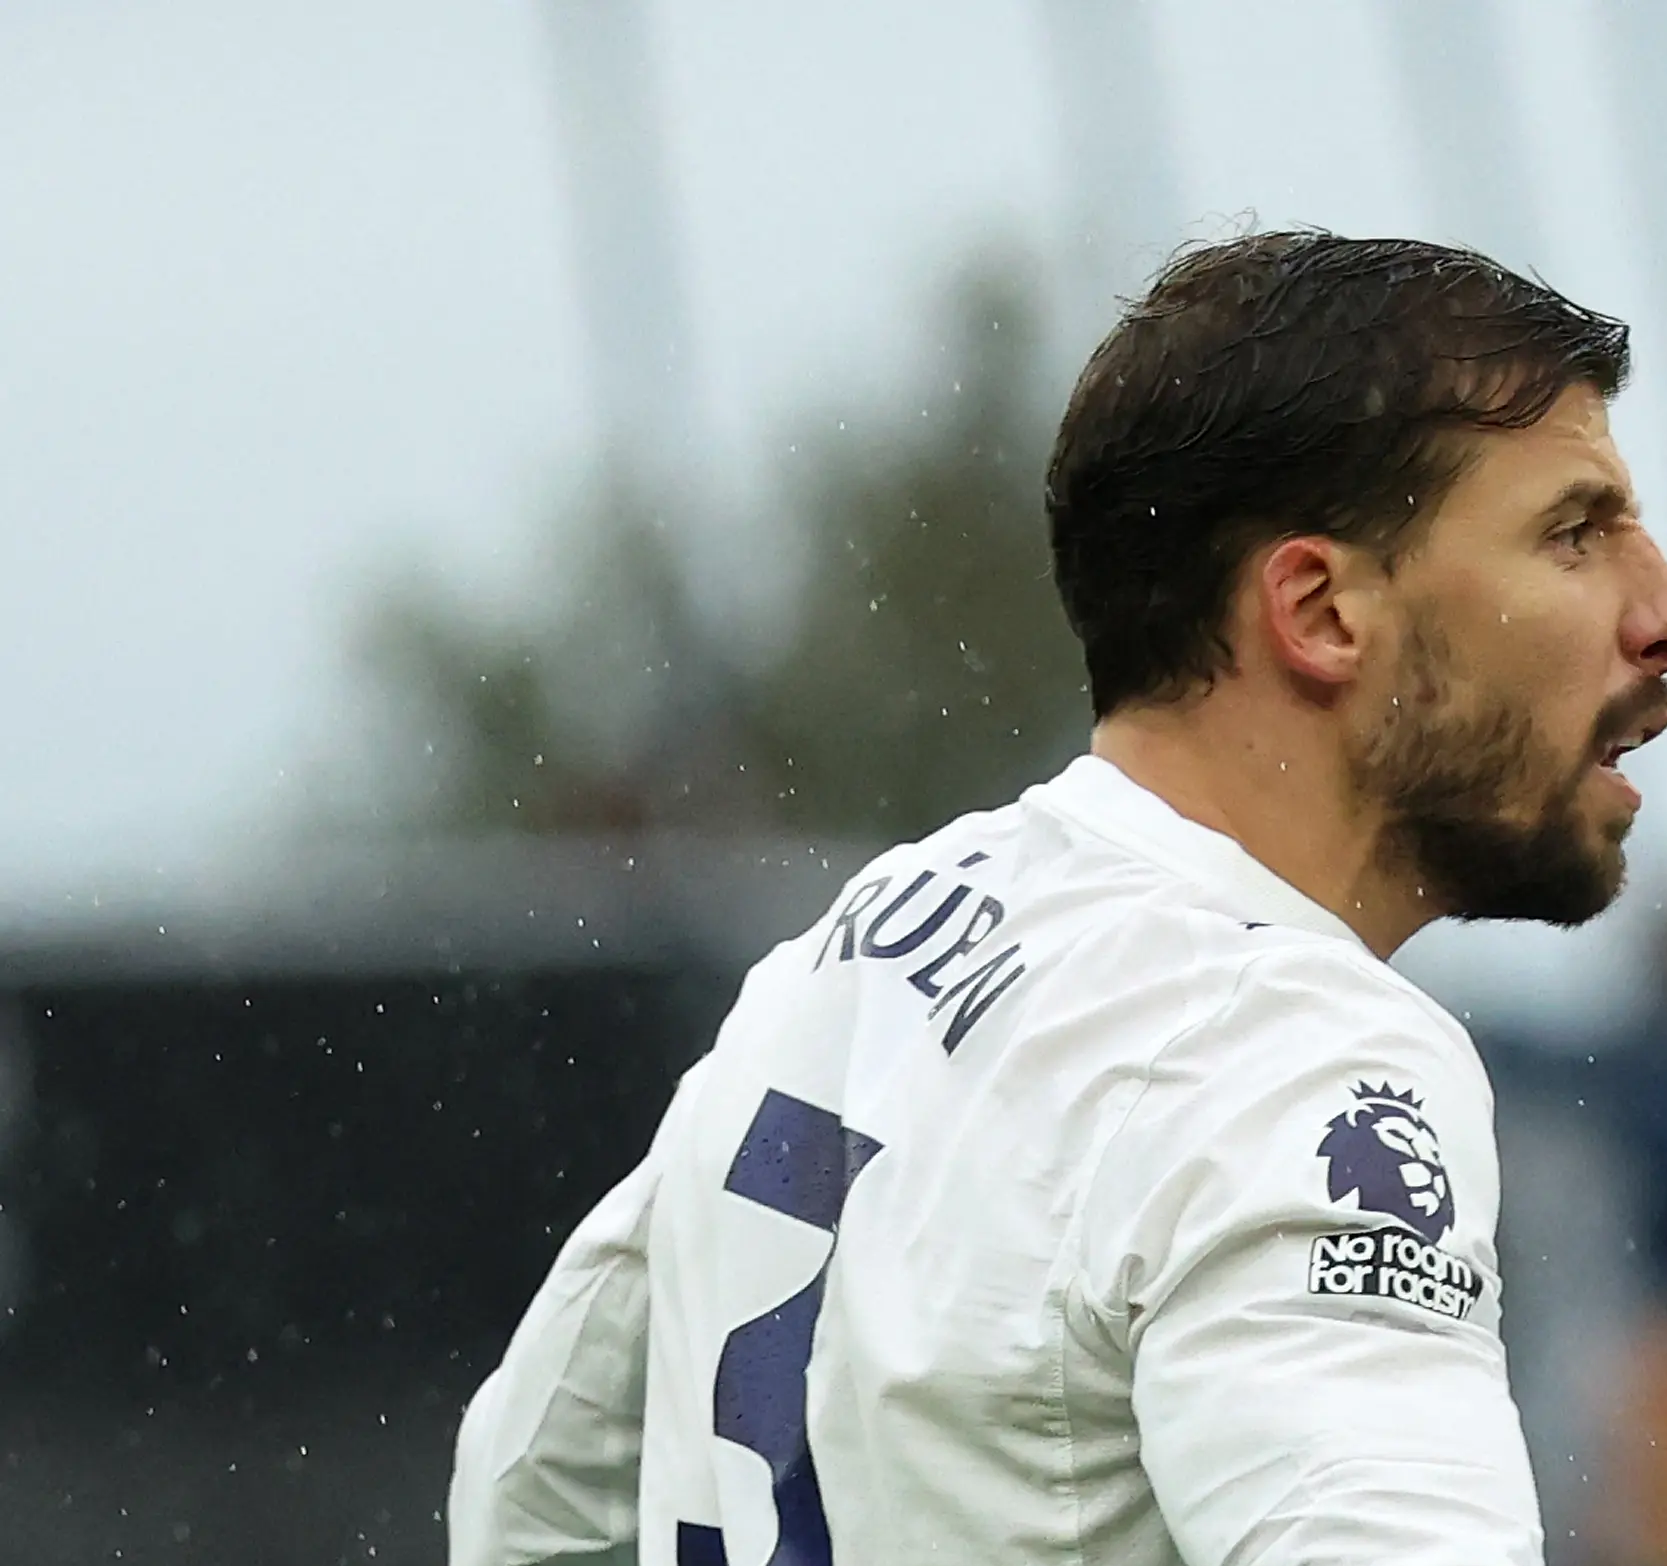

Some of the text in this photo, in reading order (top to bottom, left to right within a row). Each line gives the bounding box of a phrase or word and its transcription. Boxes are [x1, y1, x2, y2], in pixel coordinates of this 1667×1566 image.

[1310, 1259, 1477, 1320] for racism
[1313, 1234, 1472, 1289] No room
